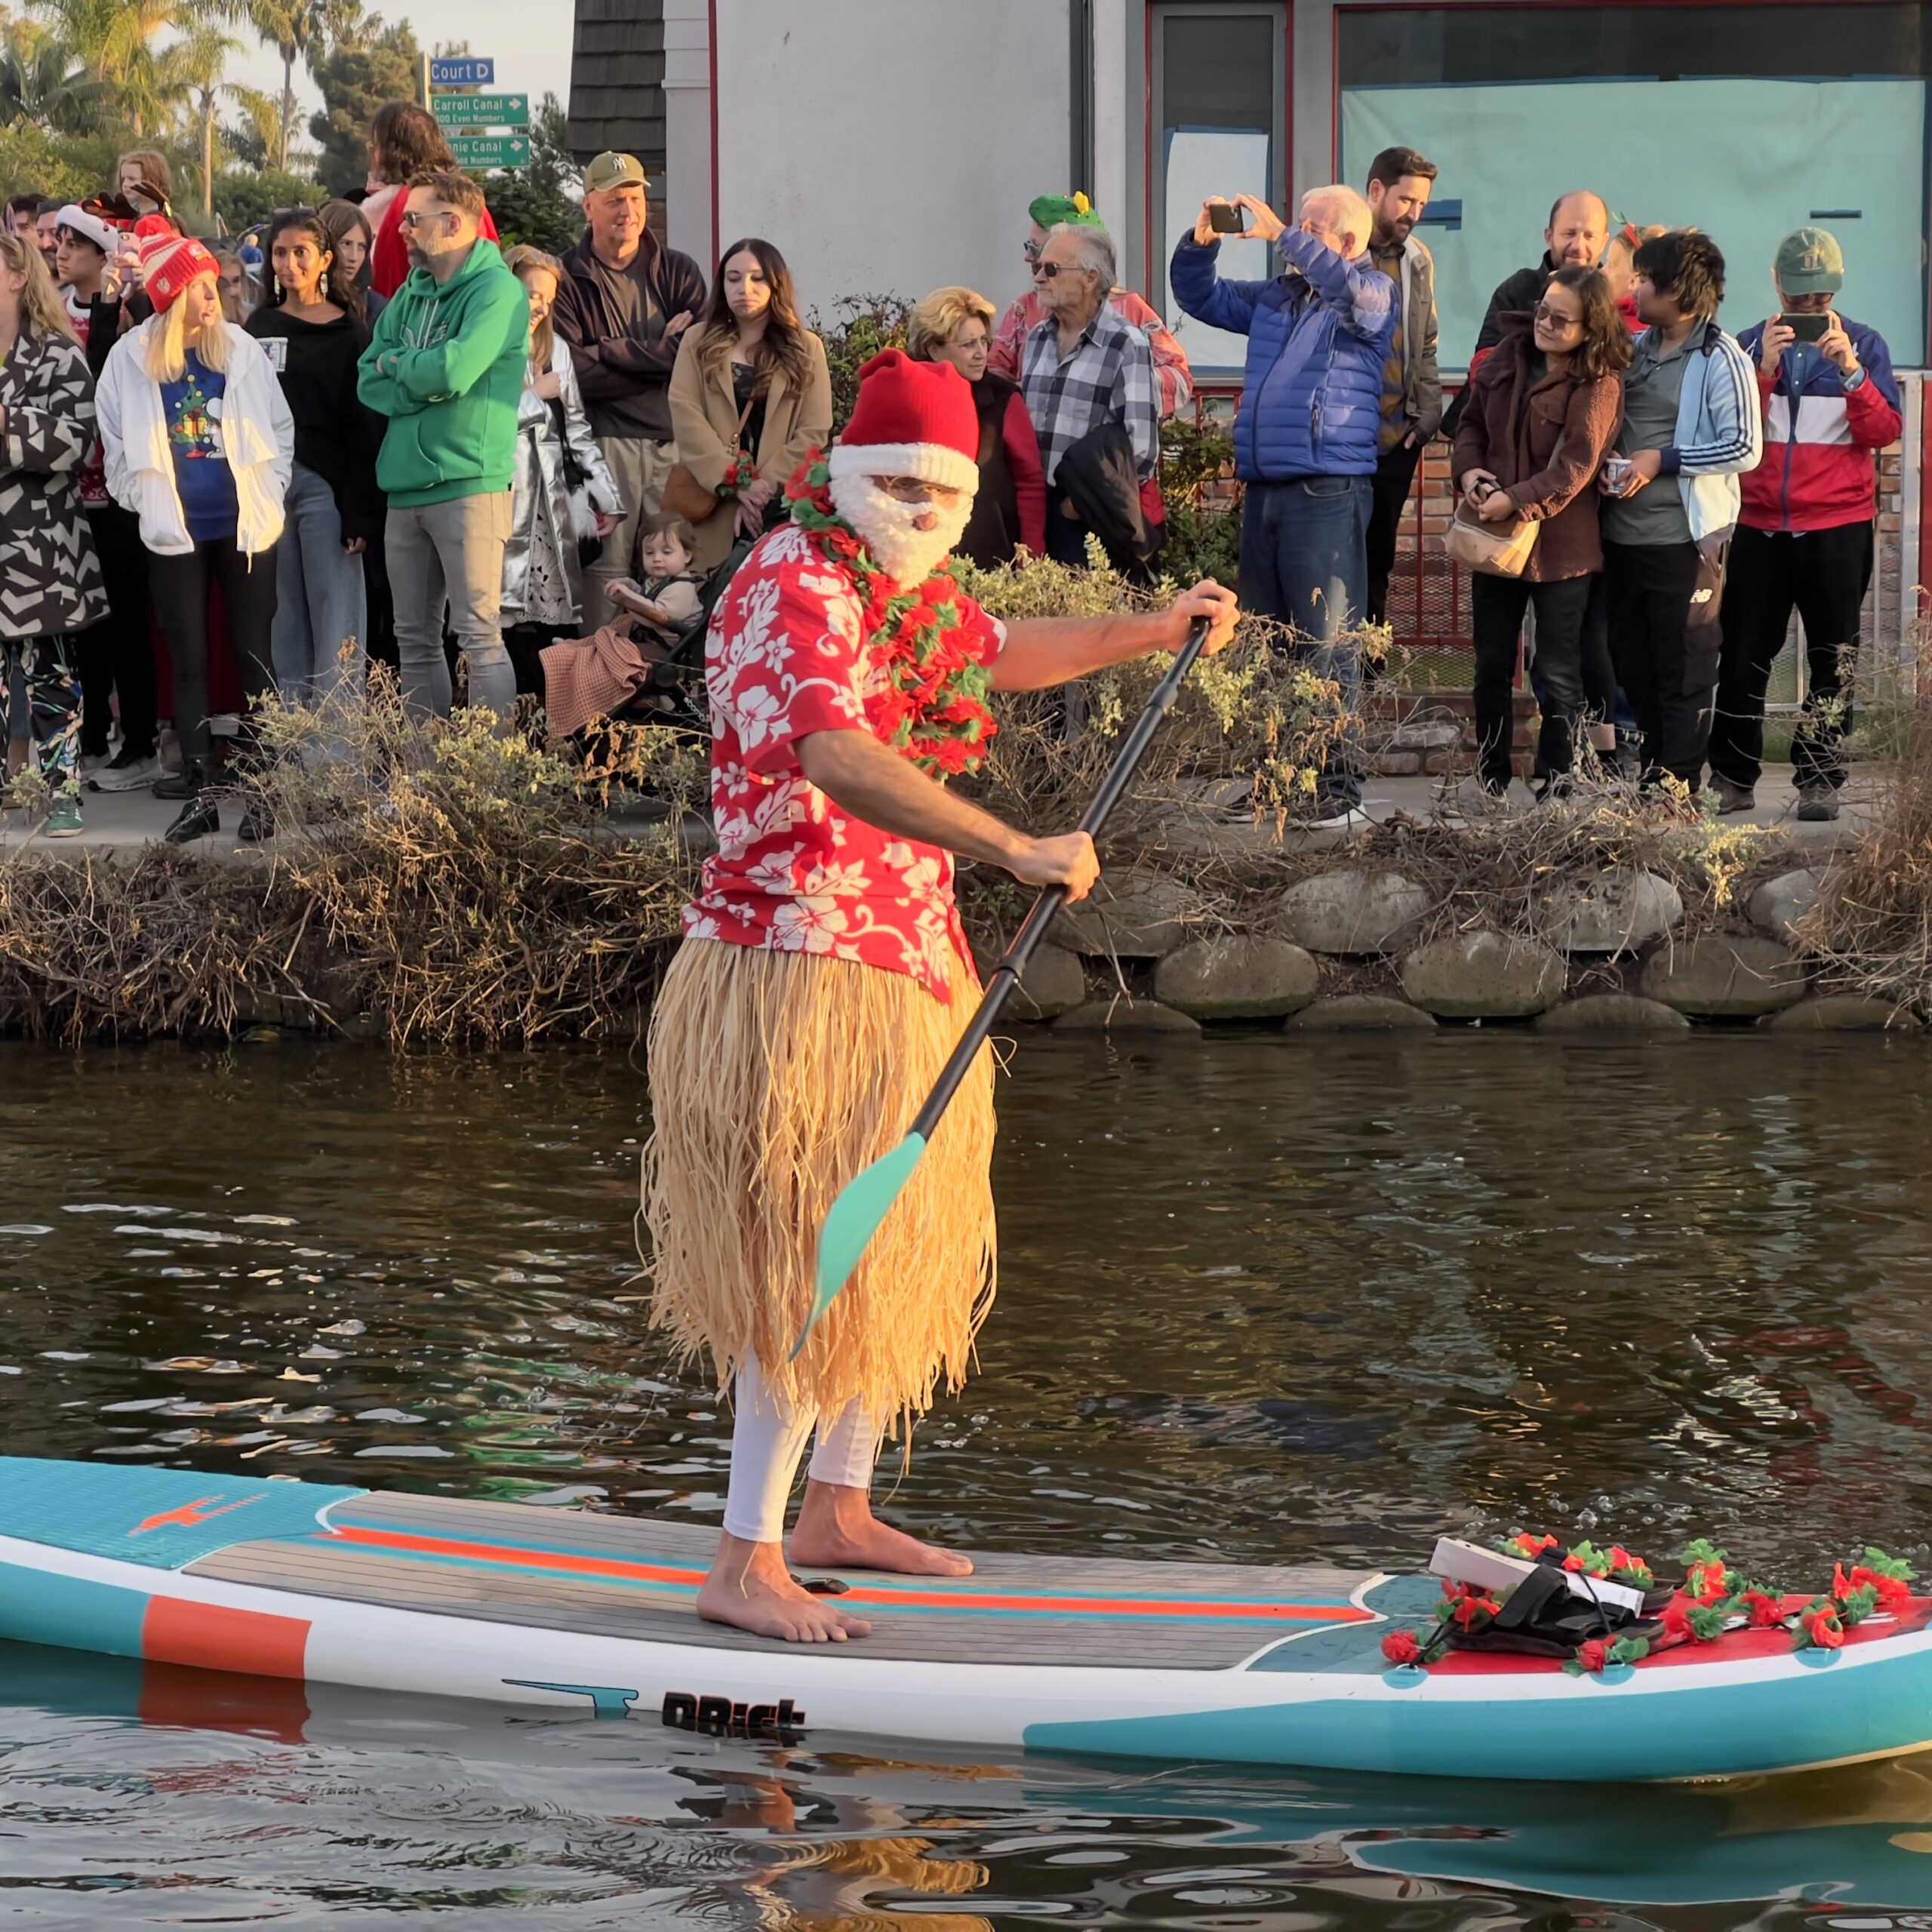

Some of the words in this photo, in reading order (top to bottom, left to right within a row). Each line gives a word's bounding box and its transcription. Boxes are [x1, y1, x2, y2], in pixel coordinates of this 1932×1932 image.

[431, 63, 472, 79] Court
[476, 63, 489, 79] D
[433, 99, 469, 110] Carroll
[472, 98, 503, 110] Canal
[452, 114, 471, 123] Even
[472, 113, 505, 123] Numbers
[472, 140, 502, 152] Canal
[470, 155, 503, 165] Numbers
